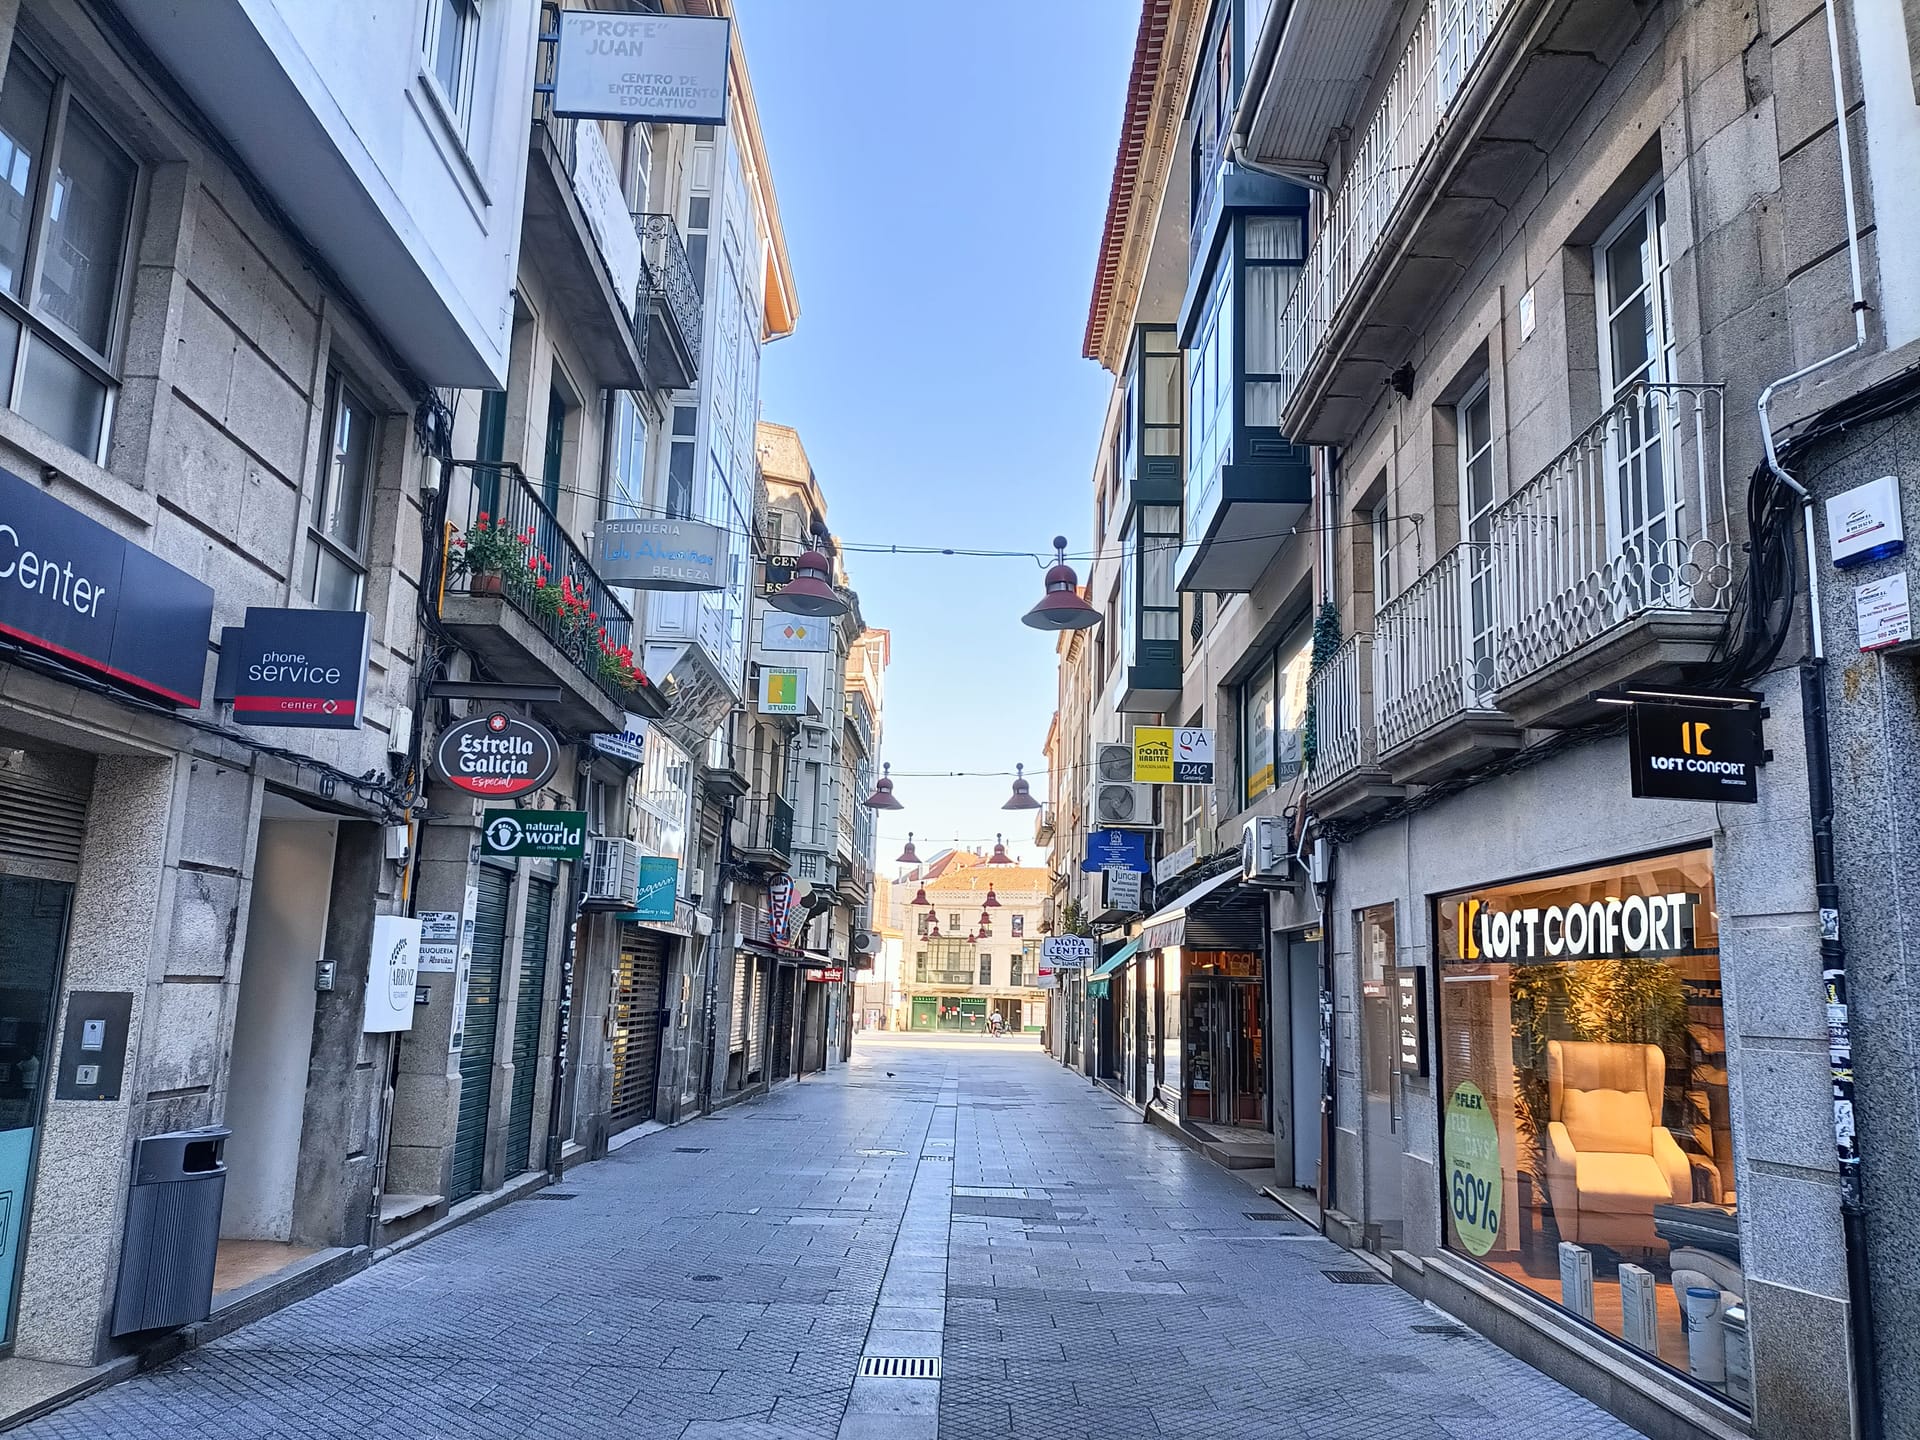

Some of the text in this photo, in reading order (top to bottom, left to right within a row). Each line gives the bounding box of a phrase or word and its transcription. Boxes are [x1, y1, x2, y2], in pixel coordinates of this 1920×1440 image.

[585, 39, 644, 57] JUAN
[621, 73, 698, 86] CENTRO DE
[608, 84, 720, 99] ENTRENAMIENTO
[619, 96, 697, 109] EDUCATIVO
[606, 523, 680, 536] PELUQUERIA
[0, 524, 106, 618] Center
[652, 565, 711, 581] BELLEZA
[262, 651, 305, 664] phone
[248, 662, 340, 684] service
[281, 700, 317, 710] center
[768, 704, 797, 712] STUDIO
[458, 733, 533, 755] Estrella
[1139, 748, 1169, 756] PONTE
[459, 752, 528, 775] Galicia
[1180, 764, 1208, 775] DAC
[1651, 756, 1745, 775] LOFT CONFORT
[323, 779, 334, 795] 18
[471, 774, 514, 788] Especial
[525, 821, 563, 832] natural
[525, 827, 581, 846] world
[1481, 892, 1686, 958] LOFT CONFORT
[1054, 938, 1086, 947] MODA
[1049, 946, 1090, 955] CENTER
[1459, 1095, 1482, 1110] FLEX
[1464, 1136, 1490, 1161] DAYS
[1453, 1169, 1498, 1234] 60%
